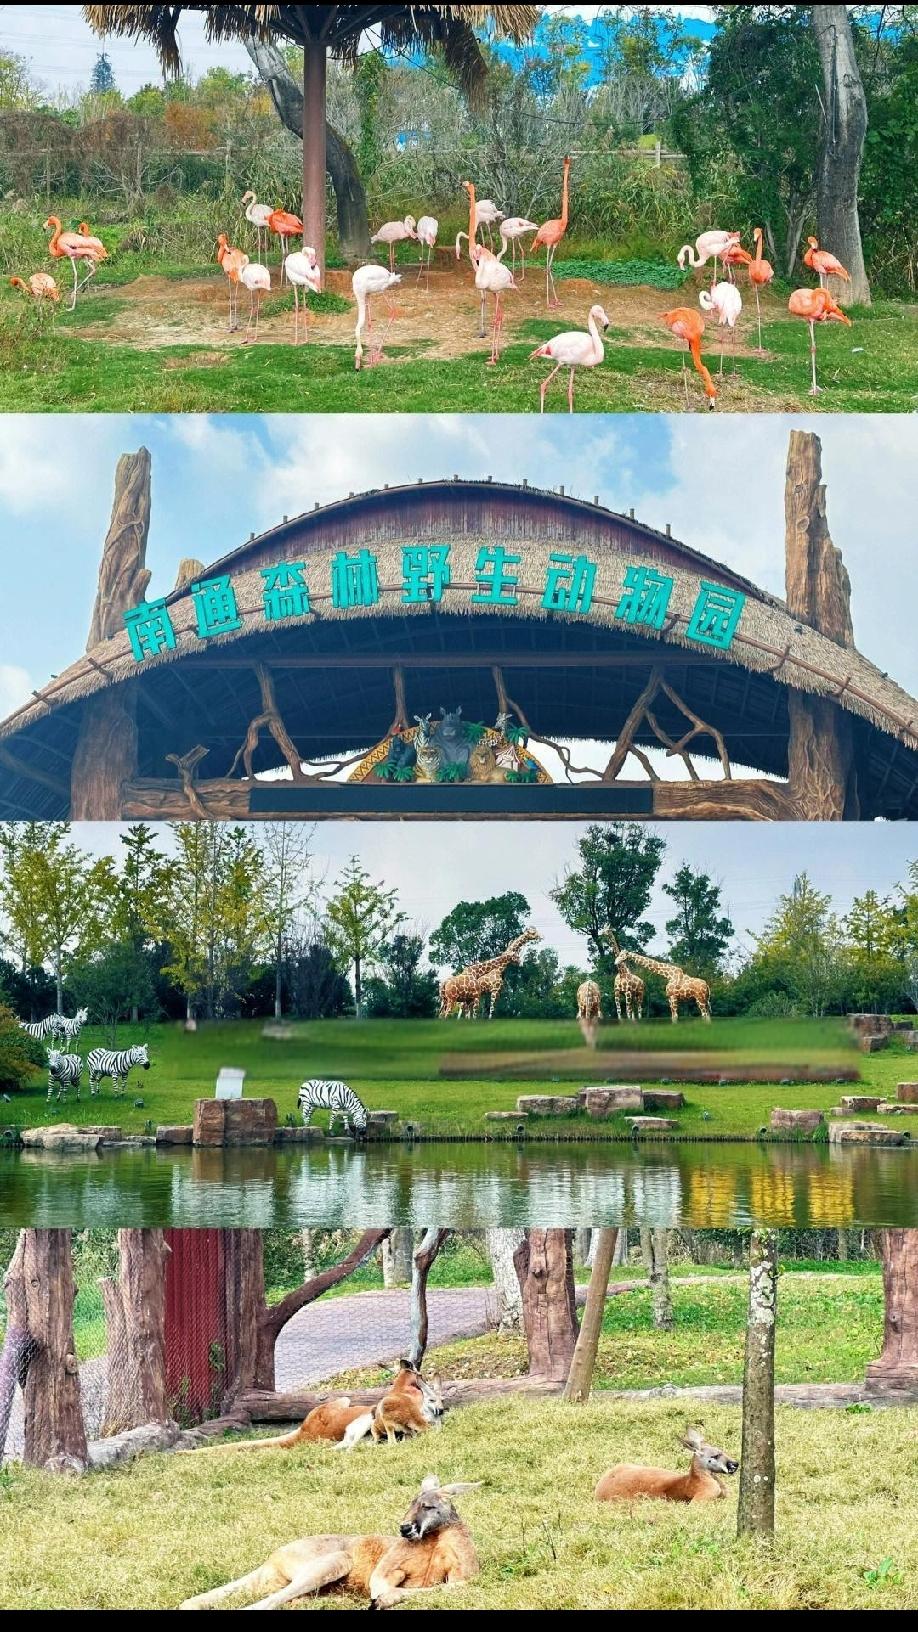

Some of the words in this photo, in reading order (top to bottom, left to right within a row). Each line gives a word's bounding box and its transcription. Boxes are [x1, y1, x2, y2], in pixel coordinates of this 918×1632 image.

[123, 544, 746, 662] 南通森林野生动物园
